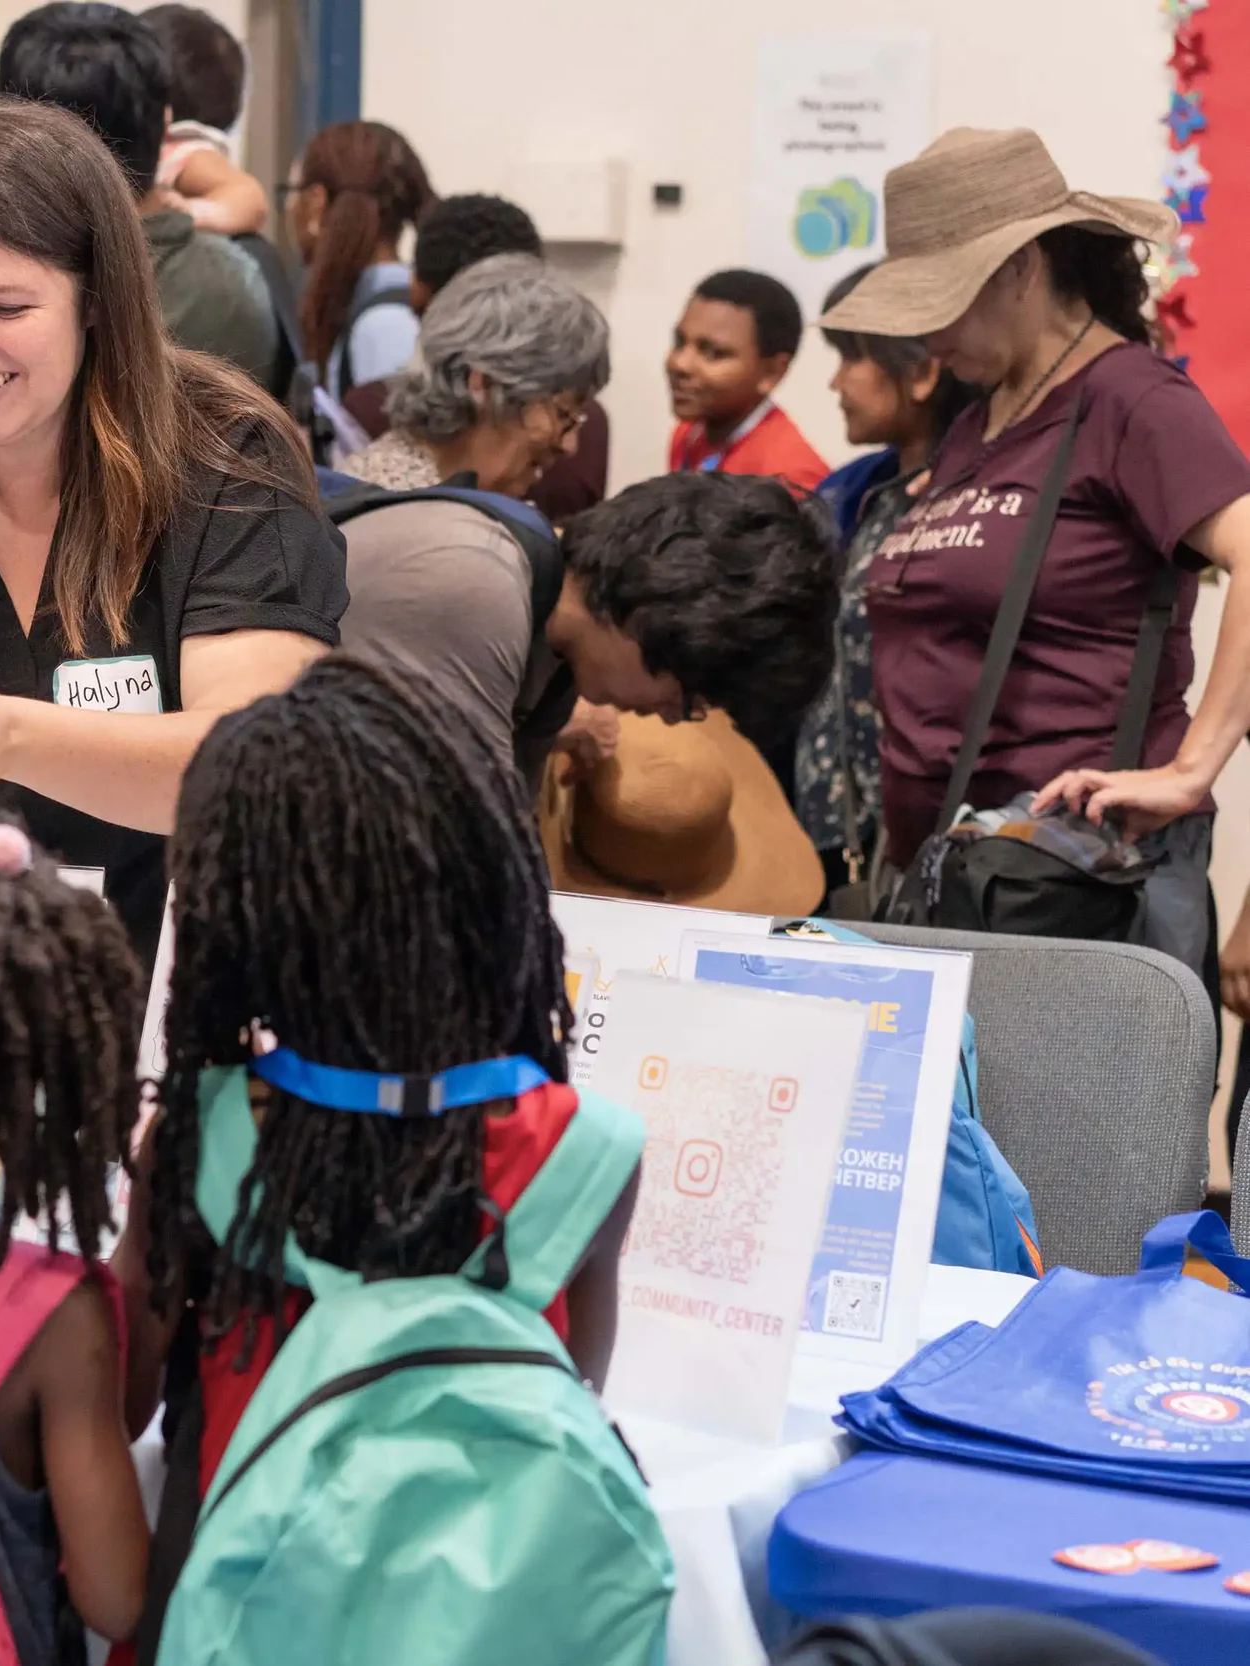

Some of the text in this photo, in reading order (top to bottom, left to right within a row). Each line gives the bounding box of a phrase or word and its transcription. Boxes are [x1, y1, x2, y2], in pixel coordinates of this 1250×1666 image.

[999, 492, 1023, 516] a
[68, 668, 153, 711] Halyna
[620, 1284, 784, 1338] _COMMUNITY_CENTER
